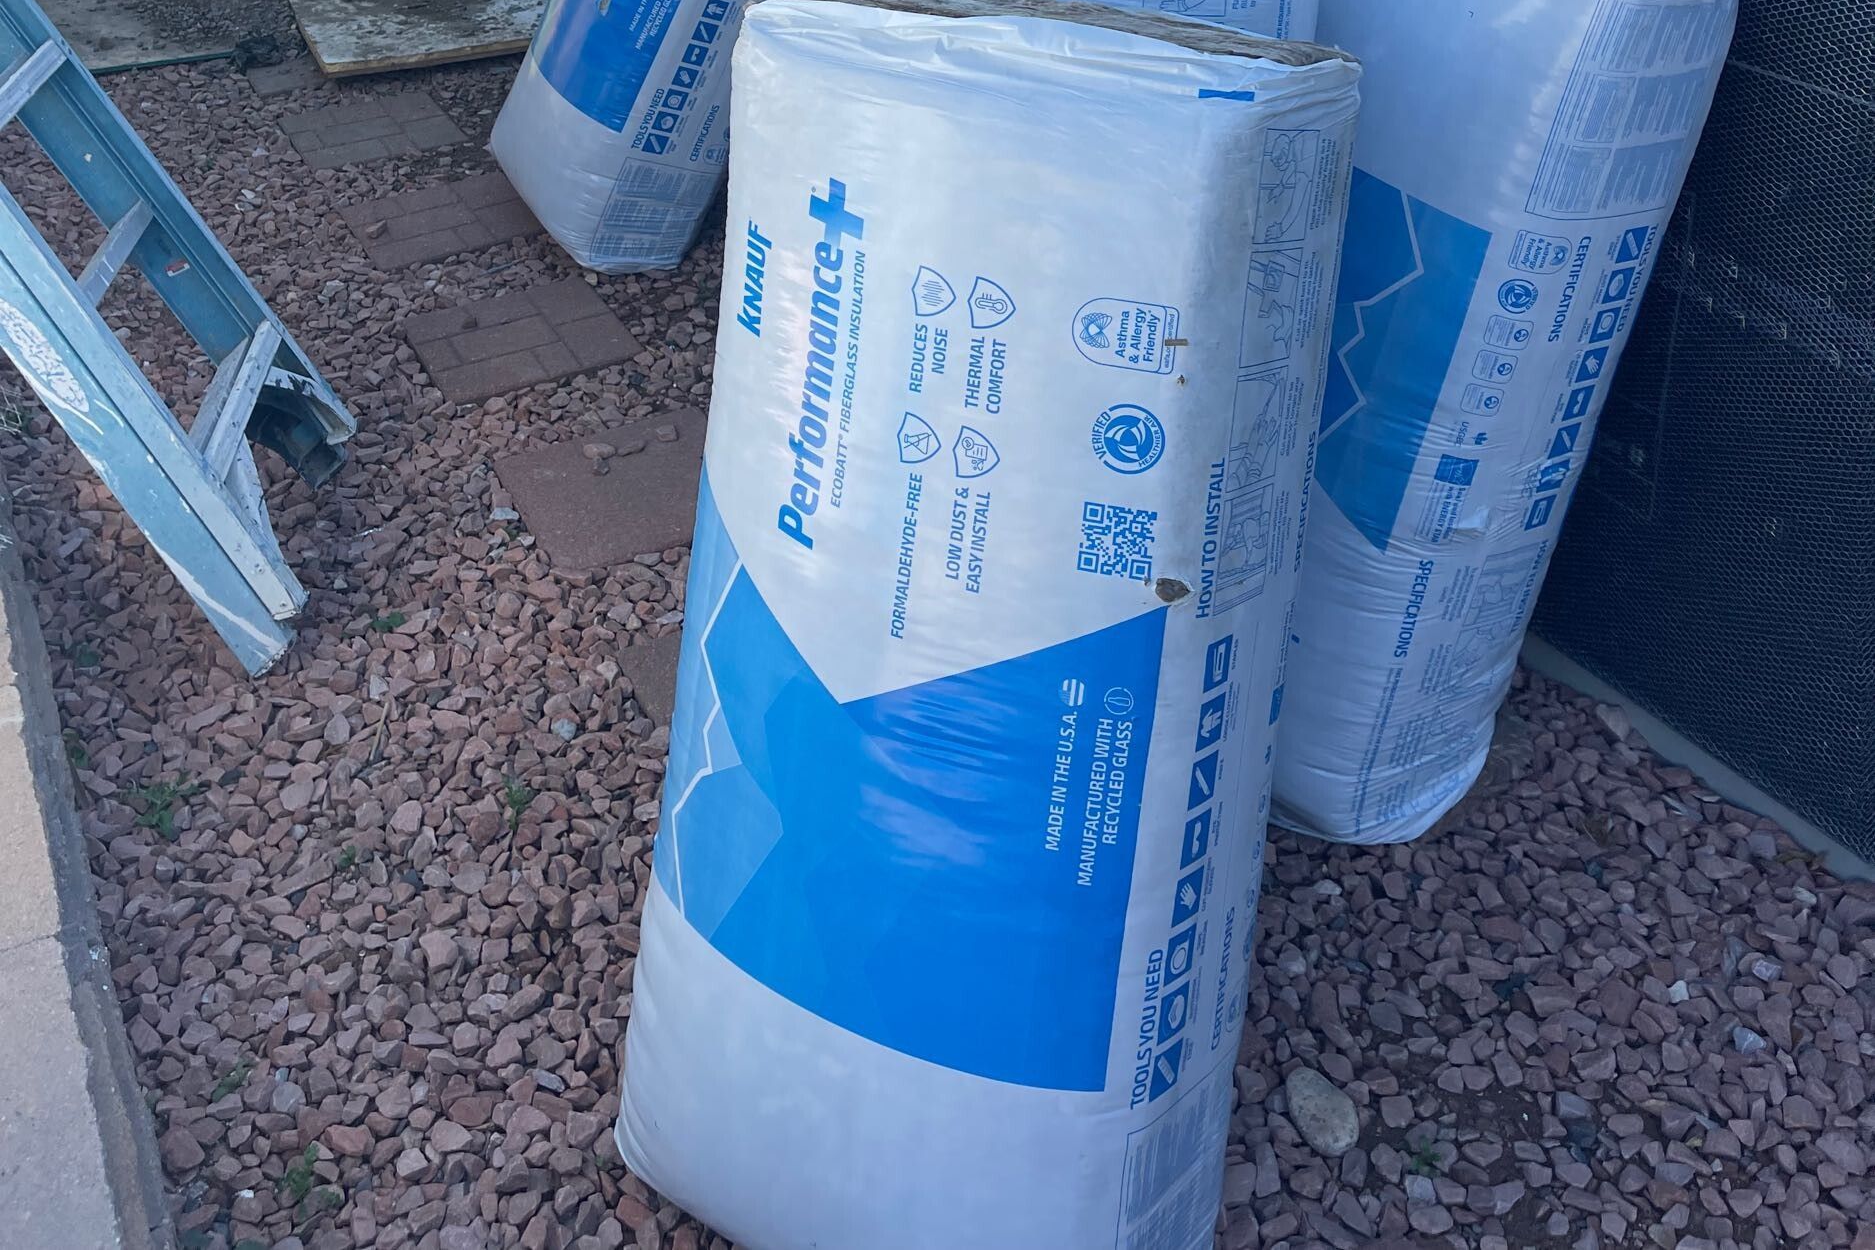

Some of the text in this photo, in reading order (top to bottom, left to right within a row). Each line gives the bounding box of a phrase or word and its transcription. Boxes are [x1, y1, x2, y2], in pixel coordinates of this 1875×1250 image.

[629, 12, 641, 32] MADE
[631, 88, 665, 150] TOOLS YOU NEED
[689, 104, 720, 162] CERTIFICATIONS
[737, 219, 773, 338] KNAUF
[1520, 238, 1537, 268] Friendly
[1529, 245, 1543, 270] Allergy
[1539, 241, 1552, 268] Asthma
[1547, 235, 1592, 343] CERTIFICATIONS
[1617, 223, 1659, 332] TOOLS YOU NEED
[841, 341, 859, 435] FIBERGLASS
[852, 250, 867, 342] INSULATION
[908, 323, 929, 394] REDUCES
[931, 327, 949, 375] NOISE
[964, 335, 986, 409] THERMAL
[986, 338, 1008, 415] COMFORT
[1114, 310, 1131, 359] Asthma
[1128, 307, 1148, 365] & Allergy
[1091, 410, 1112, 460] VERIFIED
[1138, 414, 1162, 468] HEALTHIER AIR
[945, 486, 970, 581] LOW DUST &
[966, 490, 992, 595] EASY INSTALL
[1195, 457, 1225, 619] HOW TO INSTALL
[1294, 430, 1317, 573] SPECIFICATIONS
[1437, 501, 1452, 527] ENERGY
[890, 472, 923, 640] FORMALDEHYDE-FREE
[1394, 559, 1434, 659] SPECIFICATIONS
[1045, 711, 1078, 852] MADE IN THE U.S.A.
[1077, 718, 1114, 887] MANUFACTURED WITH
[1102, 720, 1134, 845] RECYCLED GLASS
[1211, 906, 1235, 1051] CERTIFICATIONS
[1130, 948, 1164, 1110] TOOLS YOU NEED
